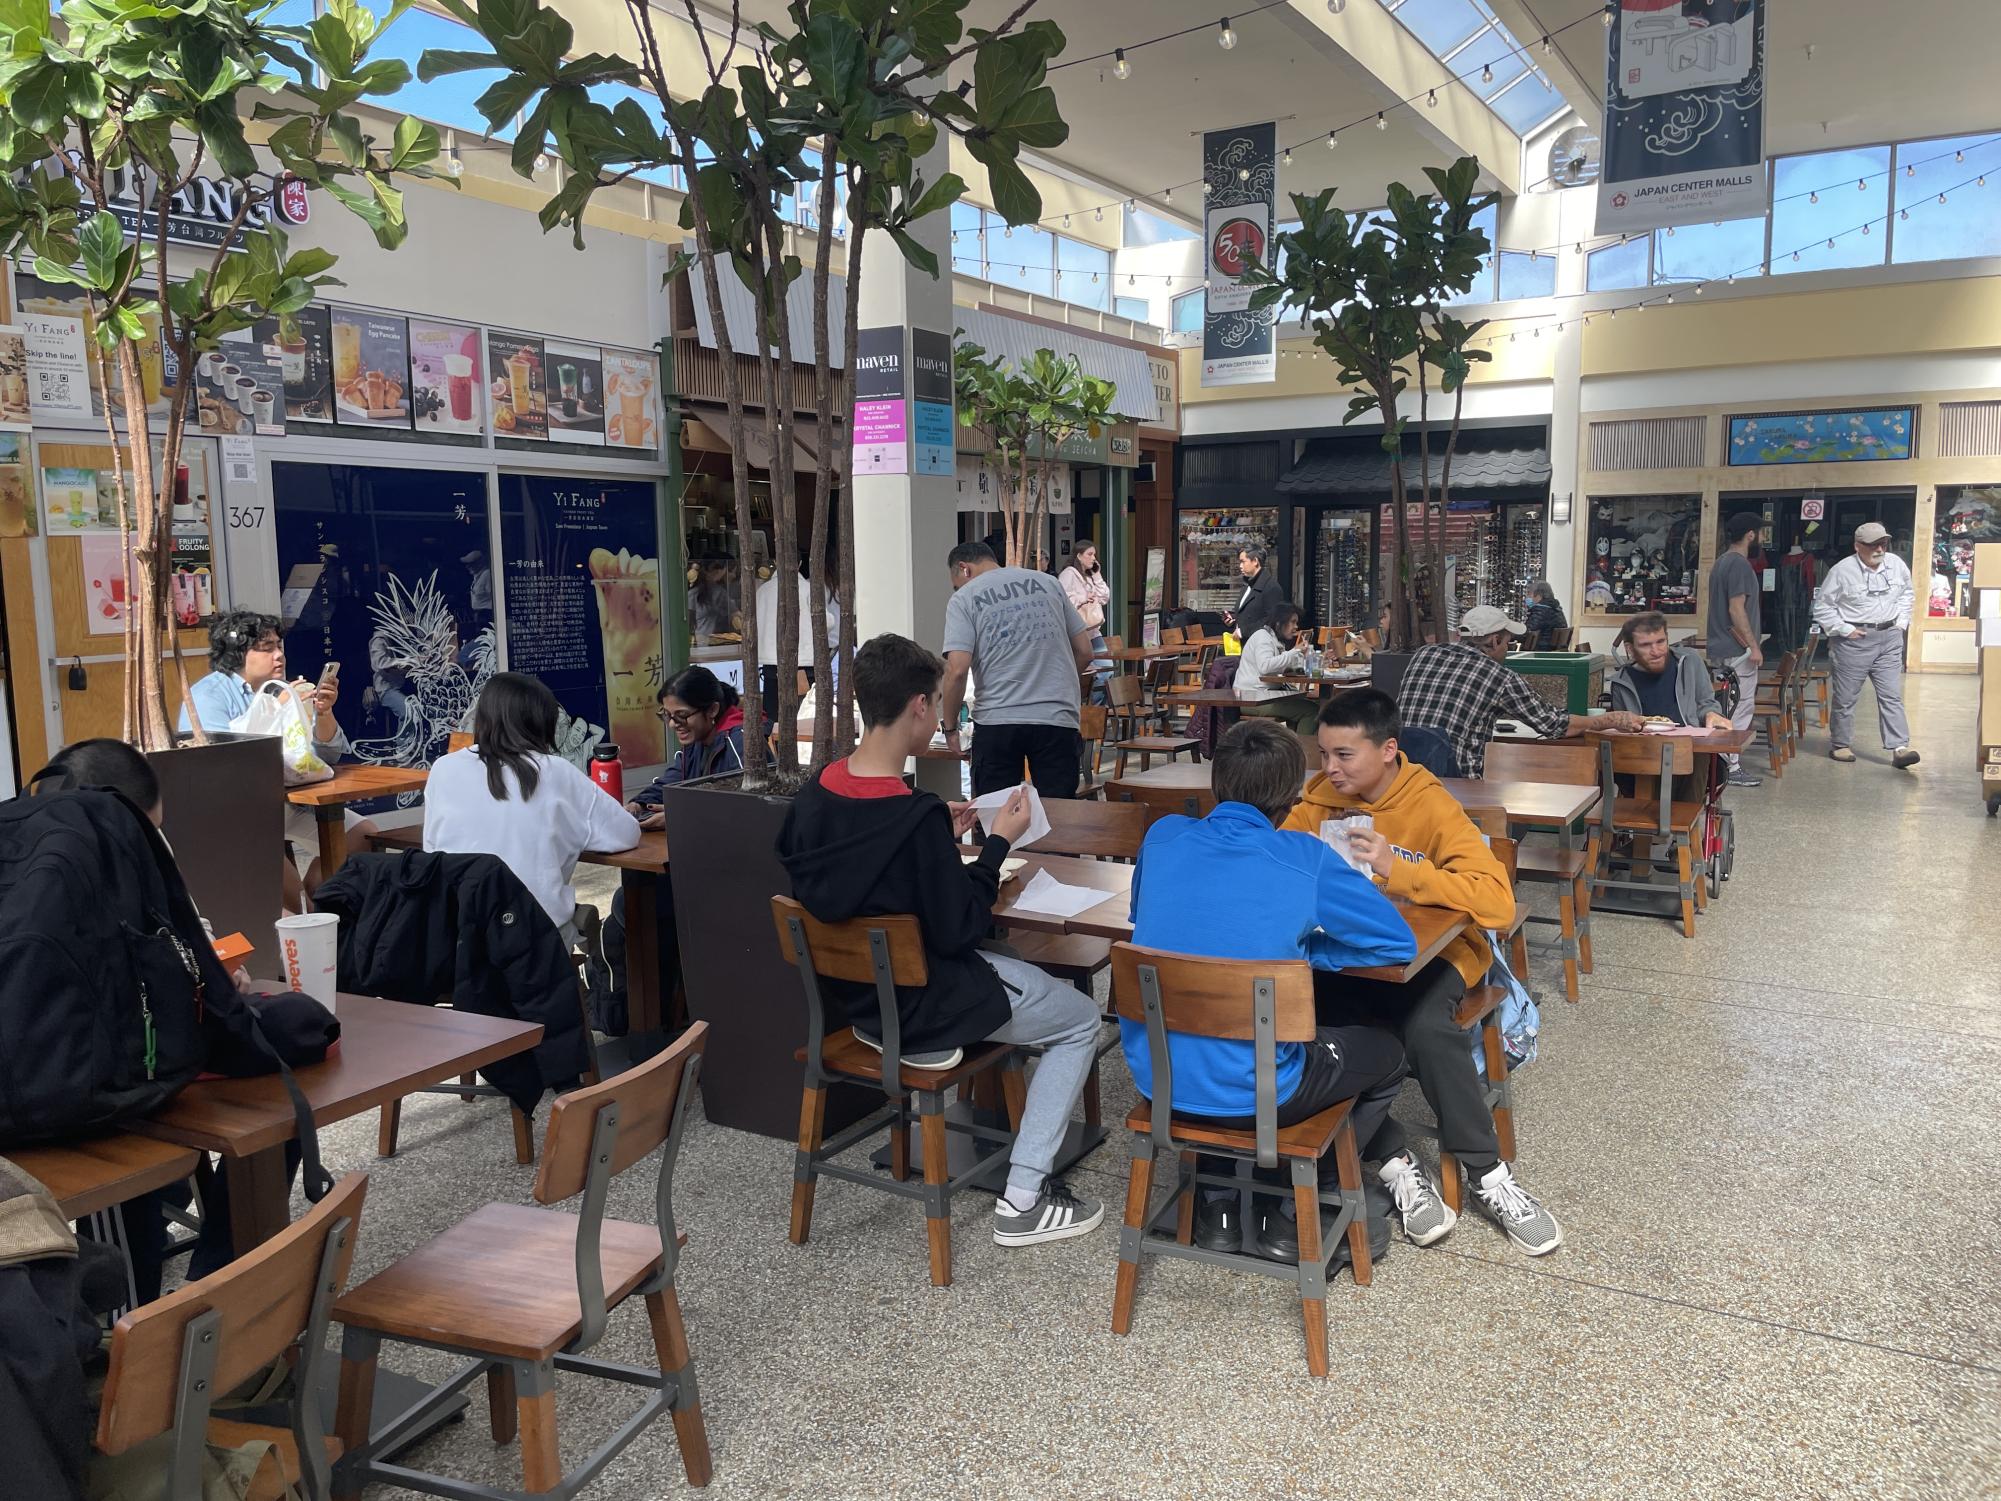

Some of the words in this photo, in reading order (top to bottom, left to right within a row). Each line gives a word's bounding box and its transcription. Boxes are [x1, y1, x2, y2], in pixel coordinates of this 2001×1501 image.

[1634, 185, 1669, 198] JAPAN
[1670, 179, 1713, 194] CENTER
[1715, 175, 1753, 187] MALLS
[121, 215, 149, 229] TEA
[25, 349, 44, 359] Skip
[45, 350, 58, 359] the
[60, 352, 77, 361] line!
[916, 356, 948, 373] maven
[1157, 364, 1169, 381] TO
[229, 506, 265, 529] 367
[178, 538, 204, 546] FRUITY
[178, 543, 210, 551] OOLONG
[973, 578, 1048, 612] NIJIYA
[285, 938, 303, 992] peyes
